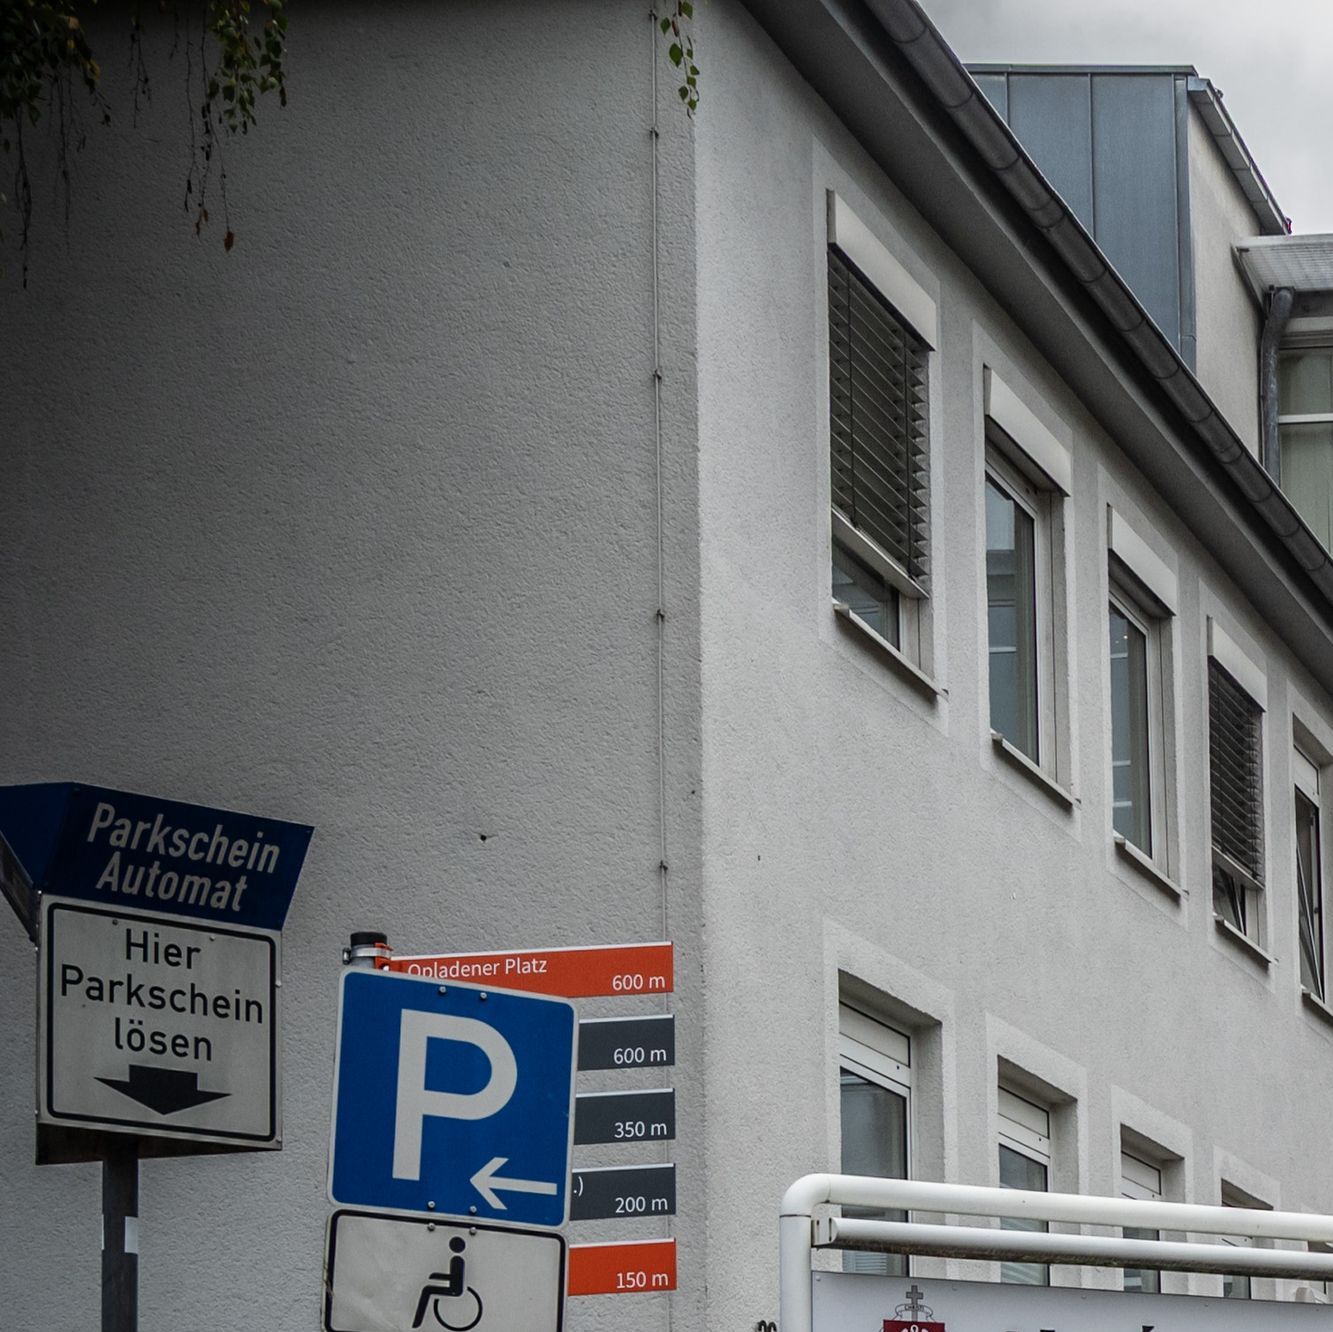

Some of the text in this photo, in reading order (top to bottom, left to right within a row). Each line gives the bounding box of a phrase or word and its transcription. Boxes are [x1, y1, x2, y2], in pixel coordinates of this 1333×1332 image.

[87, 802, 281, 874] Parkschein
[96, 851, 249, 913] Automat
[125, 928, 201, 971] Hier
[505, 958, 547, 974] Platz
[60, 964, 264, 1024] Parkschein
[612, 974, 665, 990] 600 m
[113, 1015, 213, 1063] lösen
[613, 1046, 667, 1064] 600 m
[392, 1008, 518, 1182] P
[614, 1121, 667, 1138] 350 m
[615, 1195, 668, 1213] 200 m
[616, 1271, 668, 1288] 150 m
